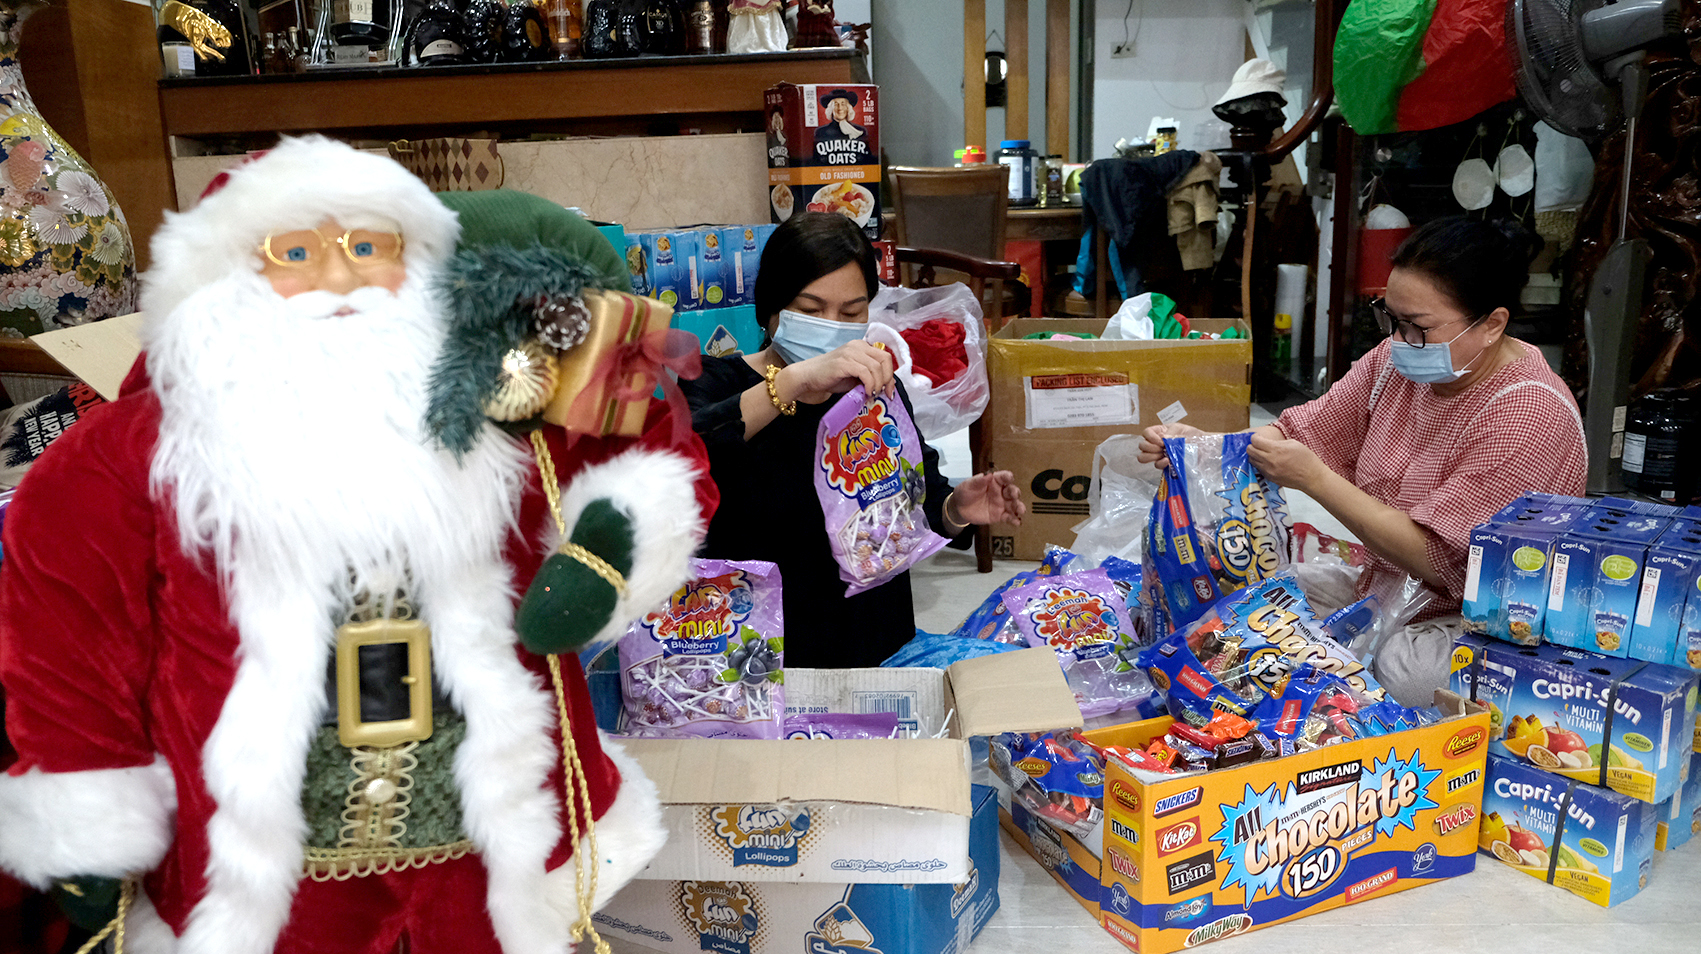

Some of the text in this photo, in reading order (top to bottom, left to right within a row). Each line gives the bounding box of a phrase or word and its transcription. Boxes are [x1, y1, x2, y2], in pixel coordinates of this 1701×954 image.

[865, 89, 871, 100] 2
[816, 140, 868, 155] QUAKER
[828, 153, 857, 164] OATS
[820, 171, 865, 180] OLD FASHIONED
[887, 245, 892, 255] 2
[1036, 376, 1067, 387] PACKING
[1069, 375, 1084, 385] LIST
[24, 417, 45, 457] NEW YEAR
[857, 457, 896, 487] mini
[860, 477, 900, 501] Blueberry
[1240, 482, 1280, 578] Choco
[1475, 534, 1503, 546] Capri-Sun
[993, 538, 1013, 556] 25
[1217, 524, 1250, 566] 150
[1560, 542, 1591, 554] Capri-Sun
[1651, 556, 1687, 570] Capri-Sun
[1262, 586, 1299, 610] All
[678, 620, 722, 640] mini
[1596, 618, 1624, 629] Capri-Sun
[671, 640, 720, 652] Blueberry
[1250, 652, 1289, 684] 15
[1454, 653, 1470, 664] 10x
[1462, 673, 1508, 695] Cri-Sun
[1531, 678, 1642, 726] Capri-Sun
[1446, 730, 1482, 752] Reese's
[1300, 762, 1360, 786] KIRKLAND
[1612, 769, 1633, 781] VEGAN
[1111, 781, 1138, 806] Reese's
[1155, 788, 1198, 813] SNICKERS
[1493, 777, 1597, 831] Capri-Sun
[1300, 794, 1327, 815] HERSHEY'S
[1233, 804, 1263, 846] All
[1243, 767, 1420, 876] Chocolate
[748, 829, 786, 849] mini
[745, 852, 790, 863] Lollipops
[1288, 829, 1374, 899] 150 PIECES
[1350, 871, 1394, 896] 100 GRAND
[1569, 871, 1589, 883] VEGAN
[698, 884, 738, 899] Deemah
[710, 922, 741, 943] mini
